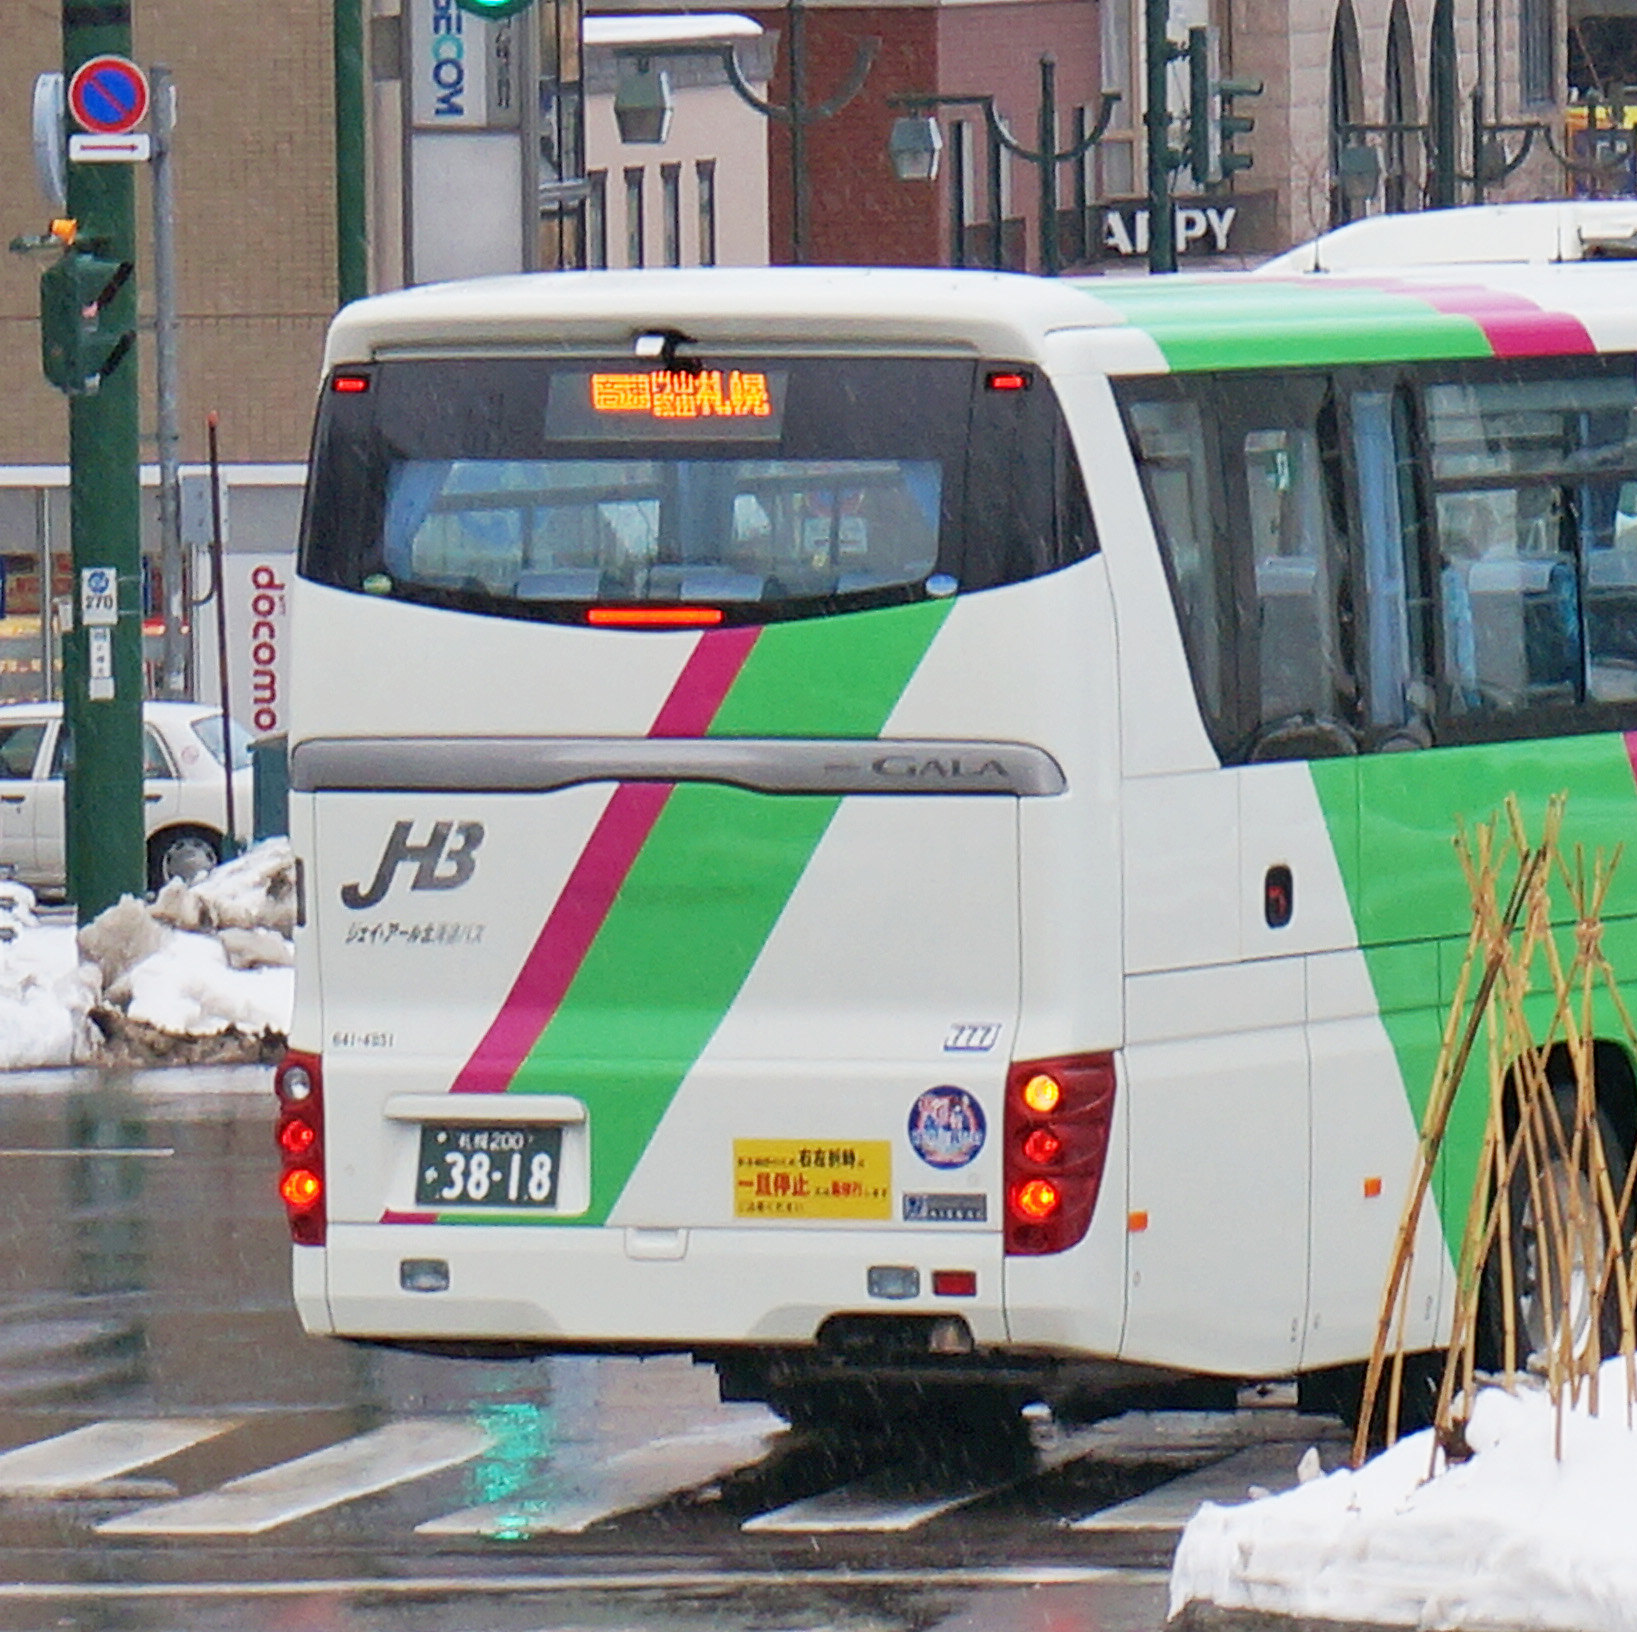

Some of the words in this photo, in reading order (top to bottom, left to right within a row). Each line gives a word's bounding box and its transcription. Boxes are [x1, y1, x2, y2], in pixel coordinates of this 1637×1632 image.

[85, 595, 114, 610] 270
[252, 565, 286, 732] docomo
[872, 754, 1009, 778] GALA
[341, 820, 485, 909] JHB
